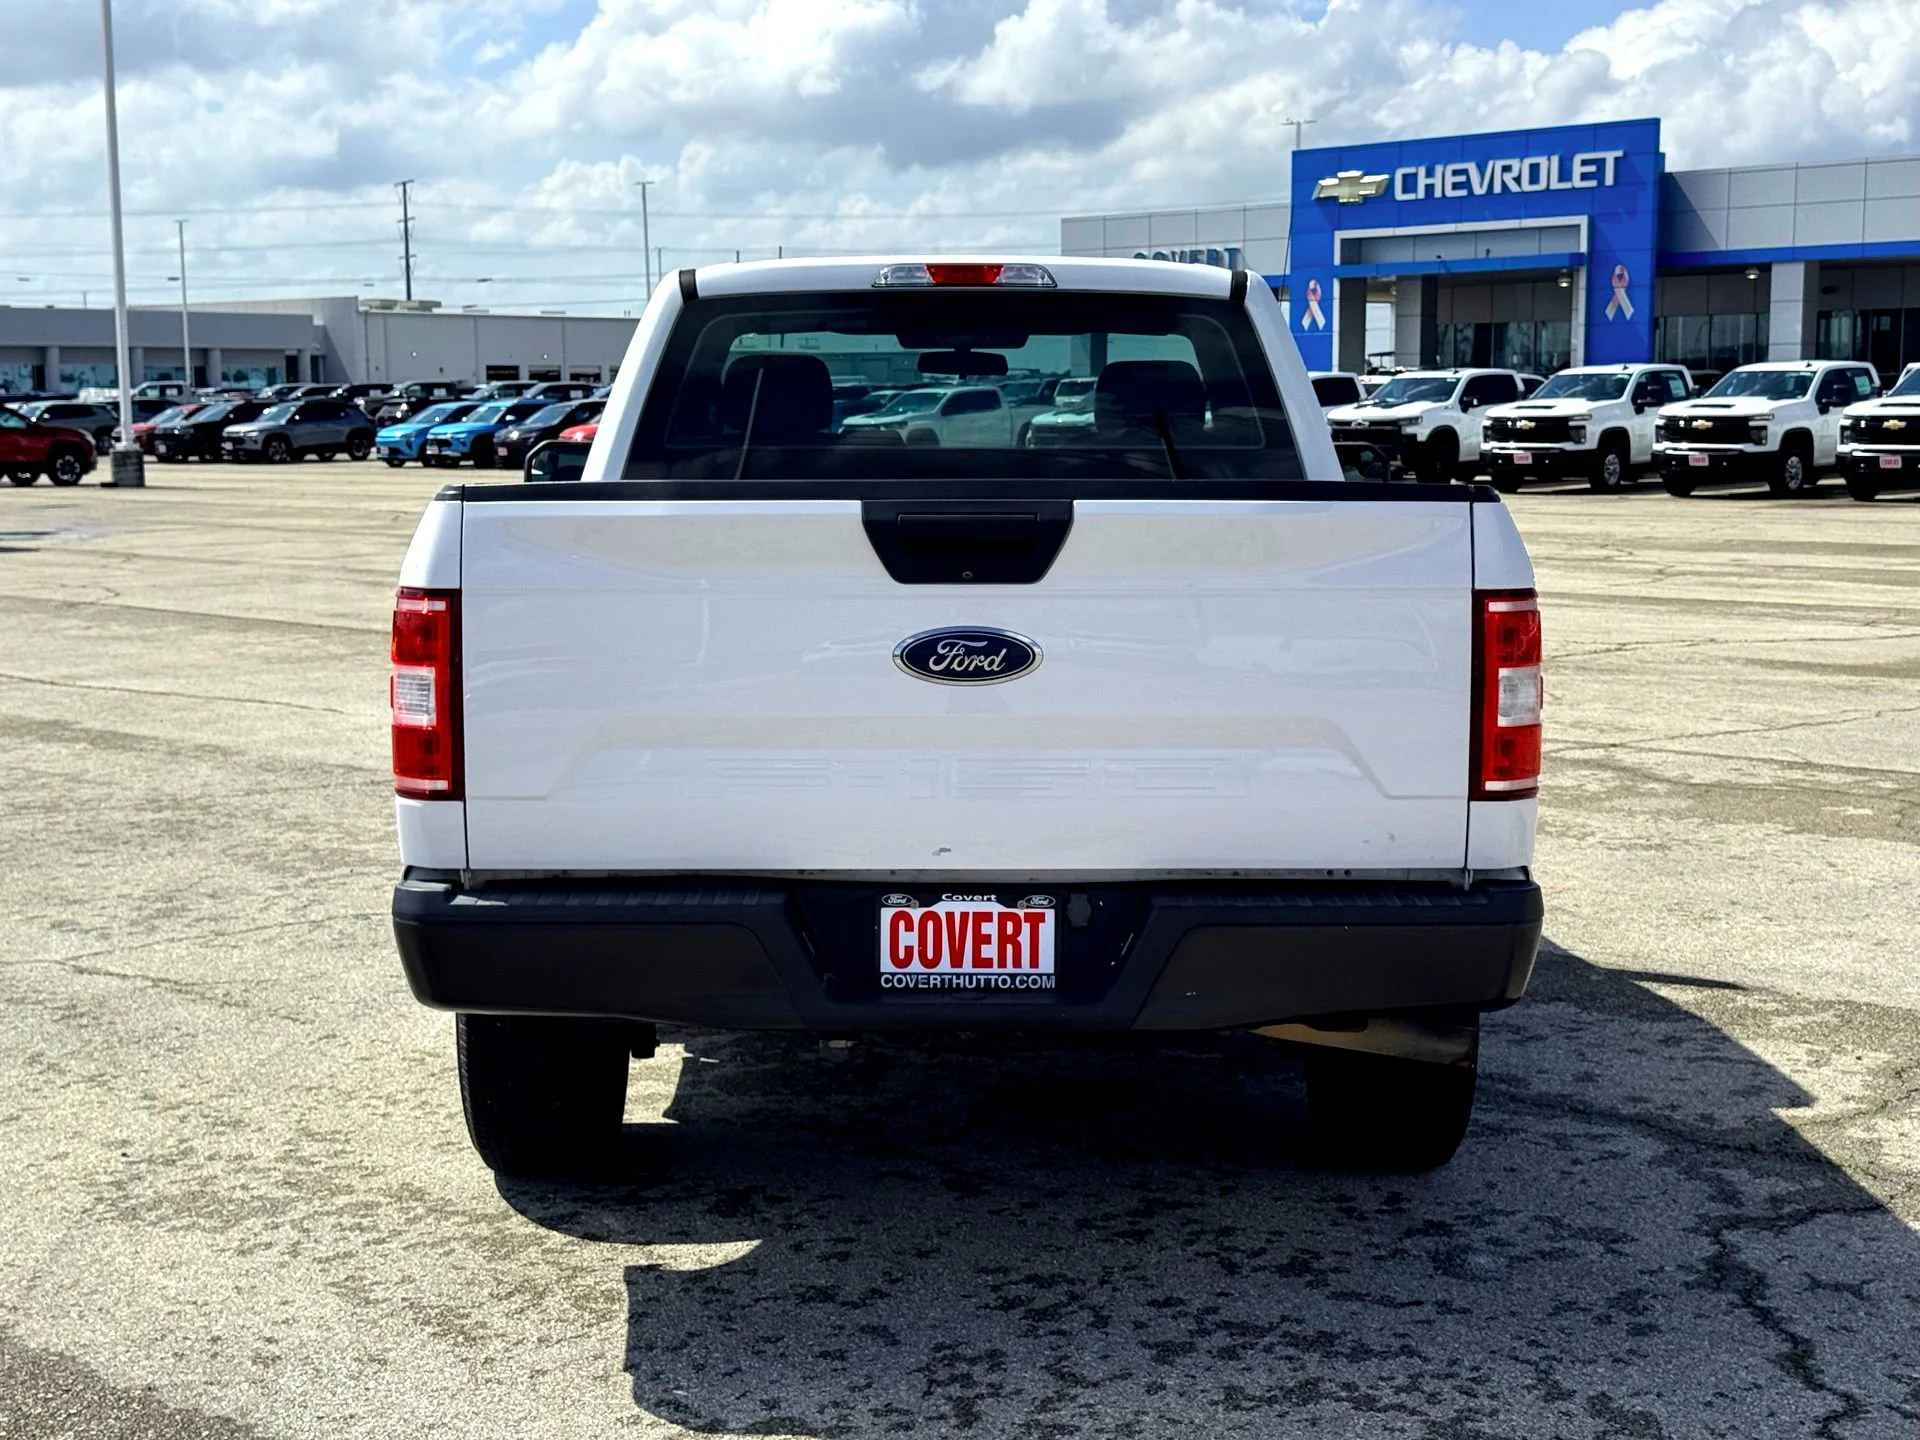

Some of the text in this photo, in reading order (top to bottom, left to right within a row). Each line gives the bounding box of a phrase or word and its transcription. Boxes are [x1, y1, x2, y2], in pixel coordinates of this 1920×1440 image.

[1394, 150, 1624, 201] CHEVROLET
[1133, 247, 1241, 271] VERT
[929, 639, 1007, 671] Ford
[941, 893, 997, 901] Covert
[889, 910, 1046, 969] COVERT
[880, 974, 1056, 989] COVERTHUTTO.COM
